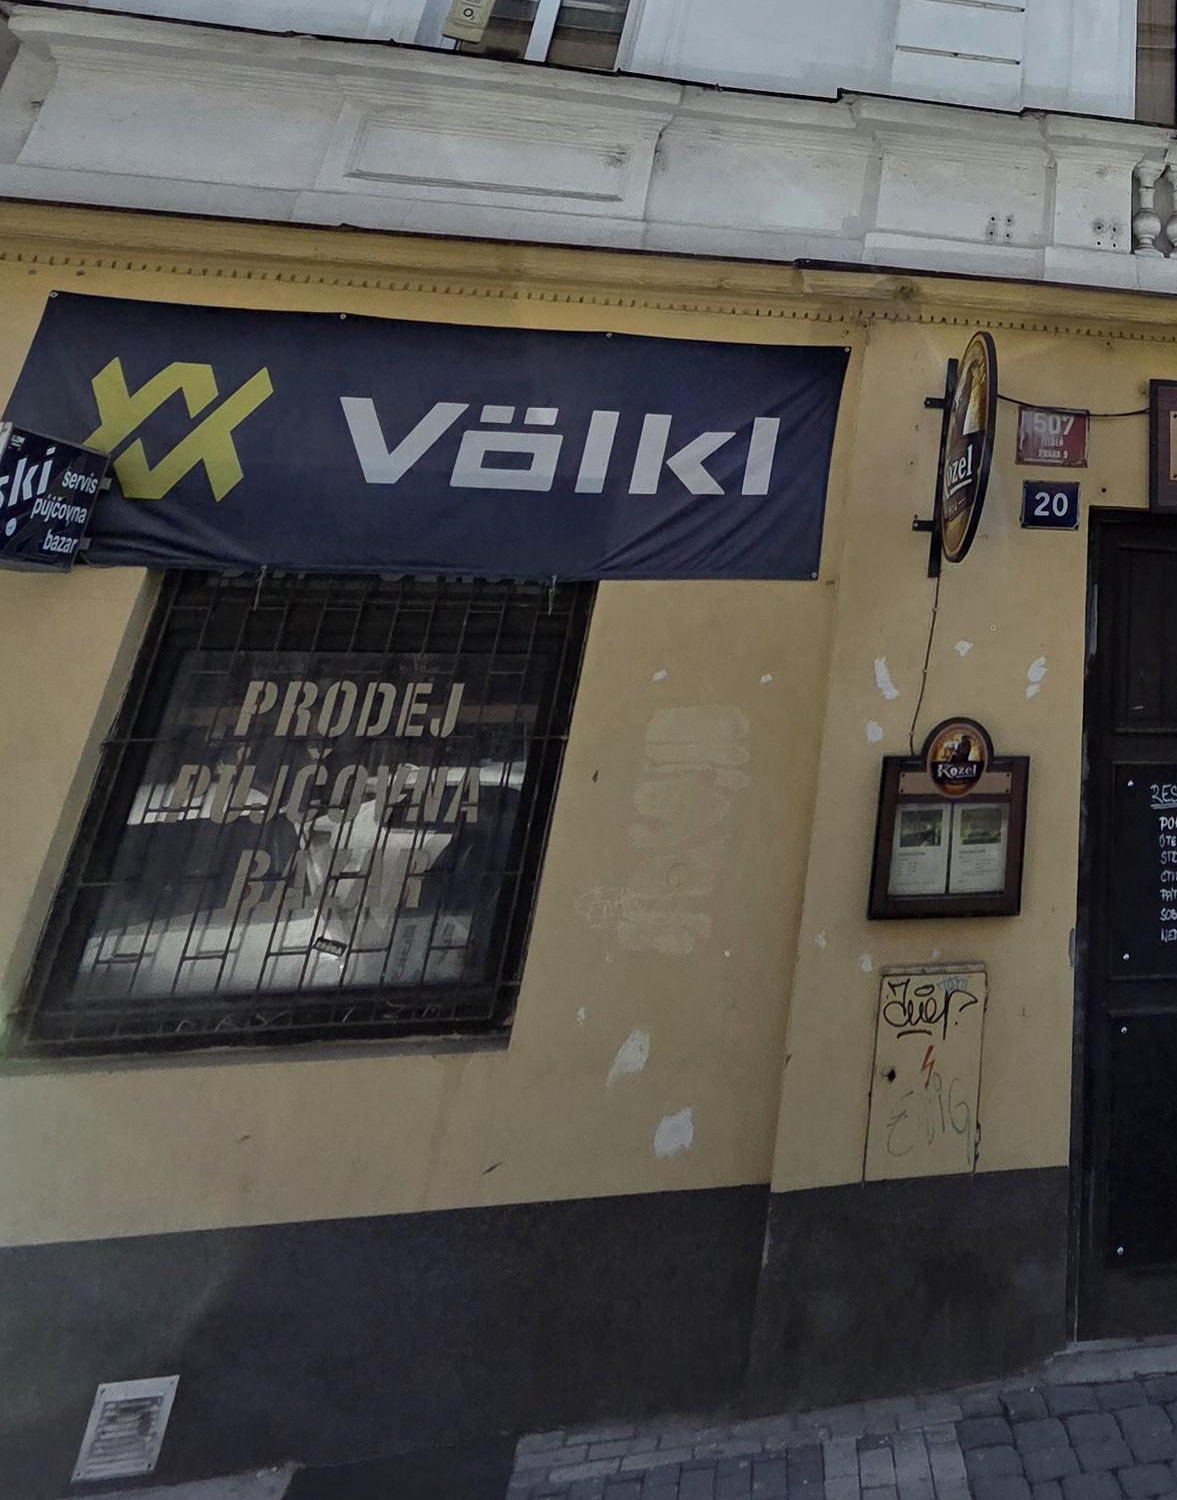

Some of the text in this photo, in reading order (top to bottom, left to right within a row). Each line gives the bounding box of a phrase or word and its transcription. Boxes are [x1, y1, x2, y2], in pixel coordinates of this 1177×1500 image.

[1033, 412, 1075, 435] 507
[340, 396, 781, 496] Völkl
[62, 470, 99, 494] servis
[1034, 491, 1068, 517] 20
[42, 528, 79, 554] bazar
[234, 680, 465, 738] PRODEJ
[937, 764, 977, 780] Kozel
